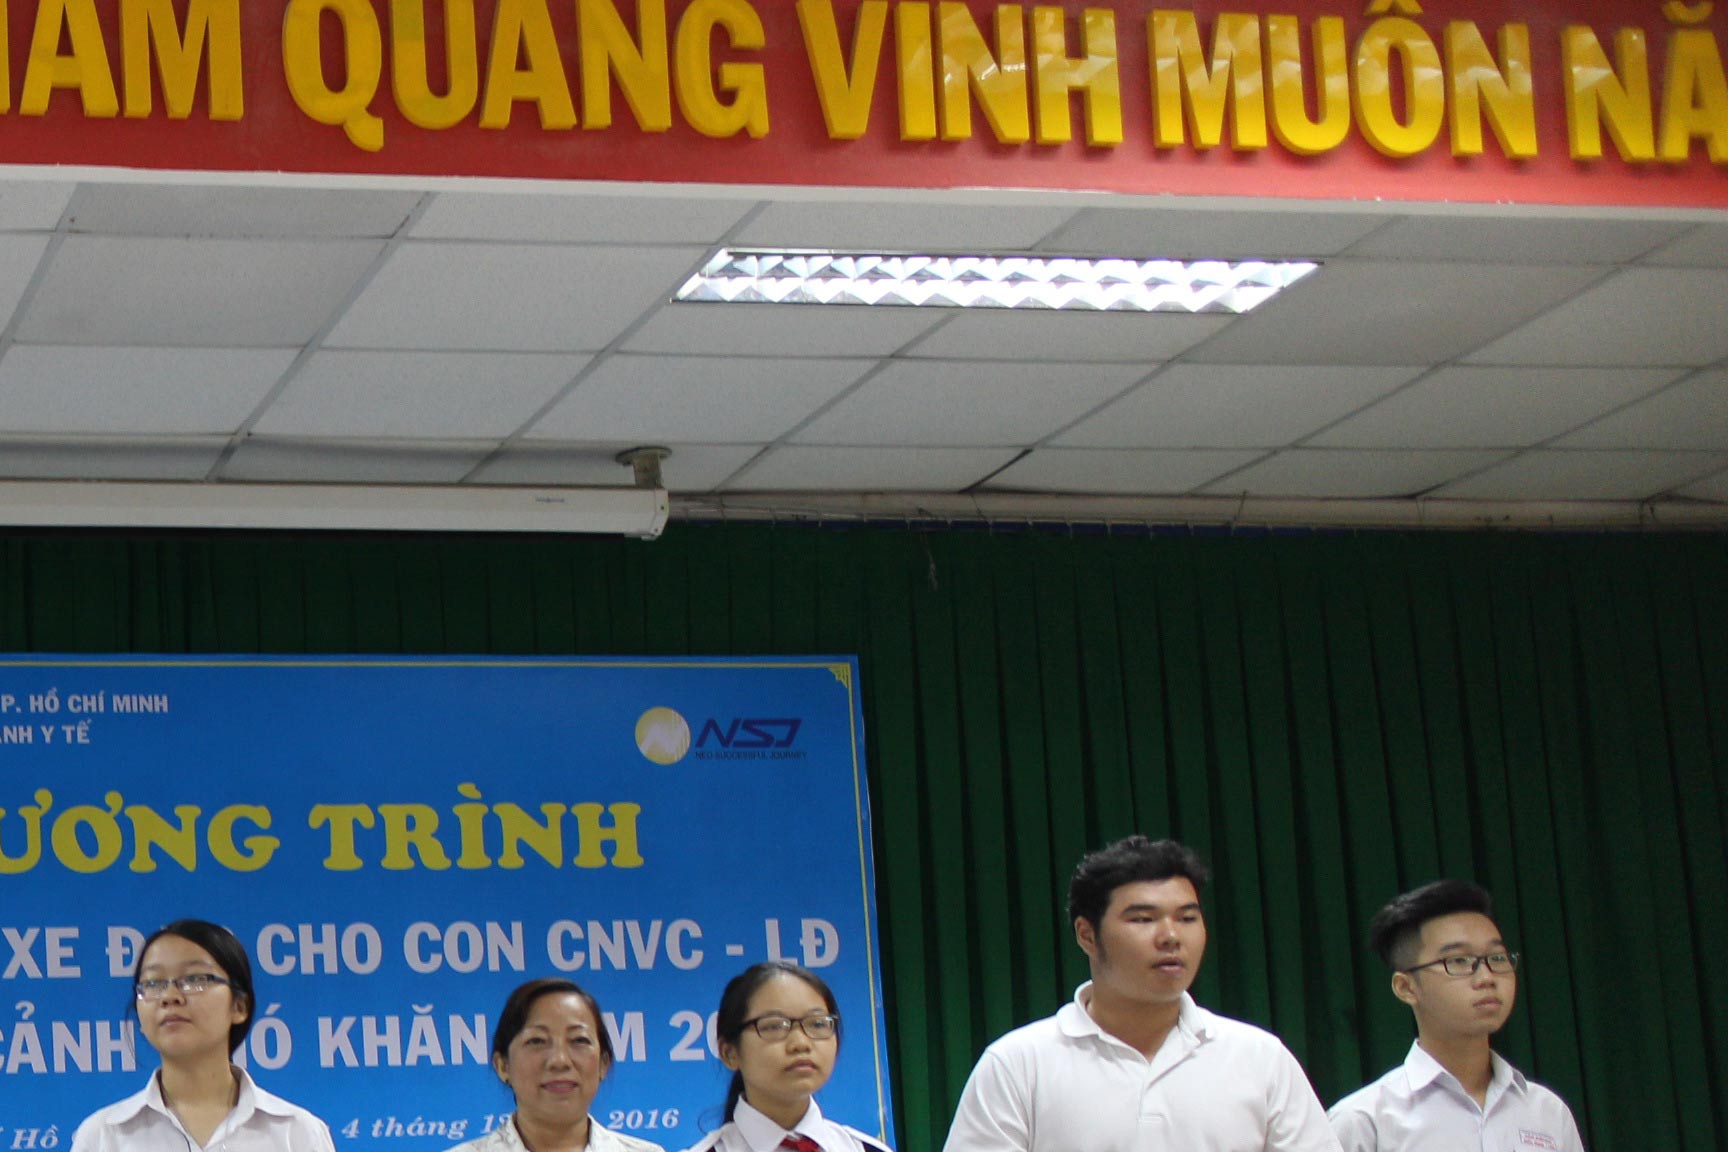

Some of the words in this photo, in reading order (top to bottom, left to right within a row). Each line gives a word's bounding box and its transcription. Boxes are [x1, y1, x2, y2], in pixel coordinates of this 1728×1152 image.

[282, 0, 770, 151] QUANG
[798, 0, 1124, 148] VINH
[1150, 0, 1539, 158] MUÔN
[68, 691, 106, 712] CHÍ
[113, 695, 168, 712] MINH
[40, 726, 55, 743] Y
[64, 718, 92, 743] TẾ
[695, 719, 801, 748] NSJ
[309, 783, 643, 870] TRÌNH
[3, 927, 81, 978] XE
[257, 923, 382, 975] CHO
[404, 921, 525, 973] CON
[547, 919, 704, 971] CNVC
[765, 918, 840, 969] LĐ
[318, 1005, 489, 1067] KHĂN
[10, 1124, 60, 1150] Hồ
[371, 1111, 469, 1140] tháng
[608, 1109, 680, 1131] 2016
